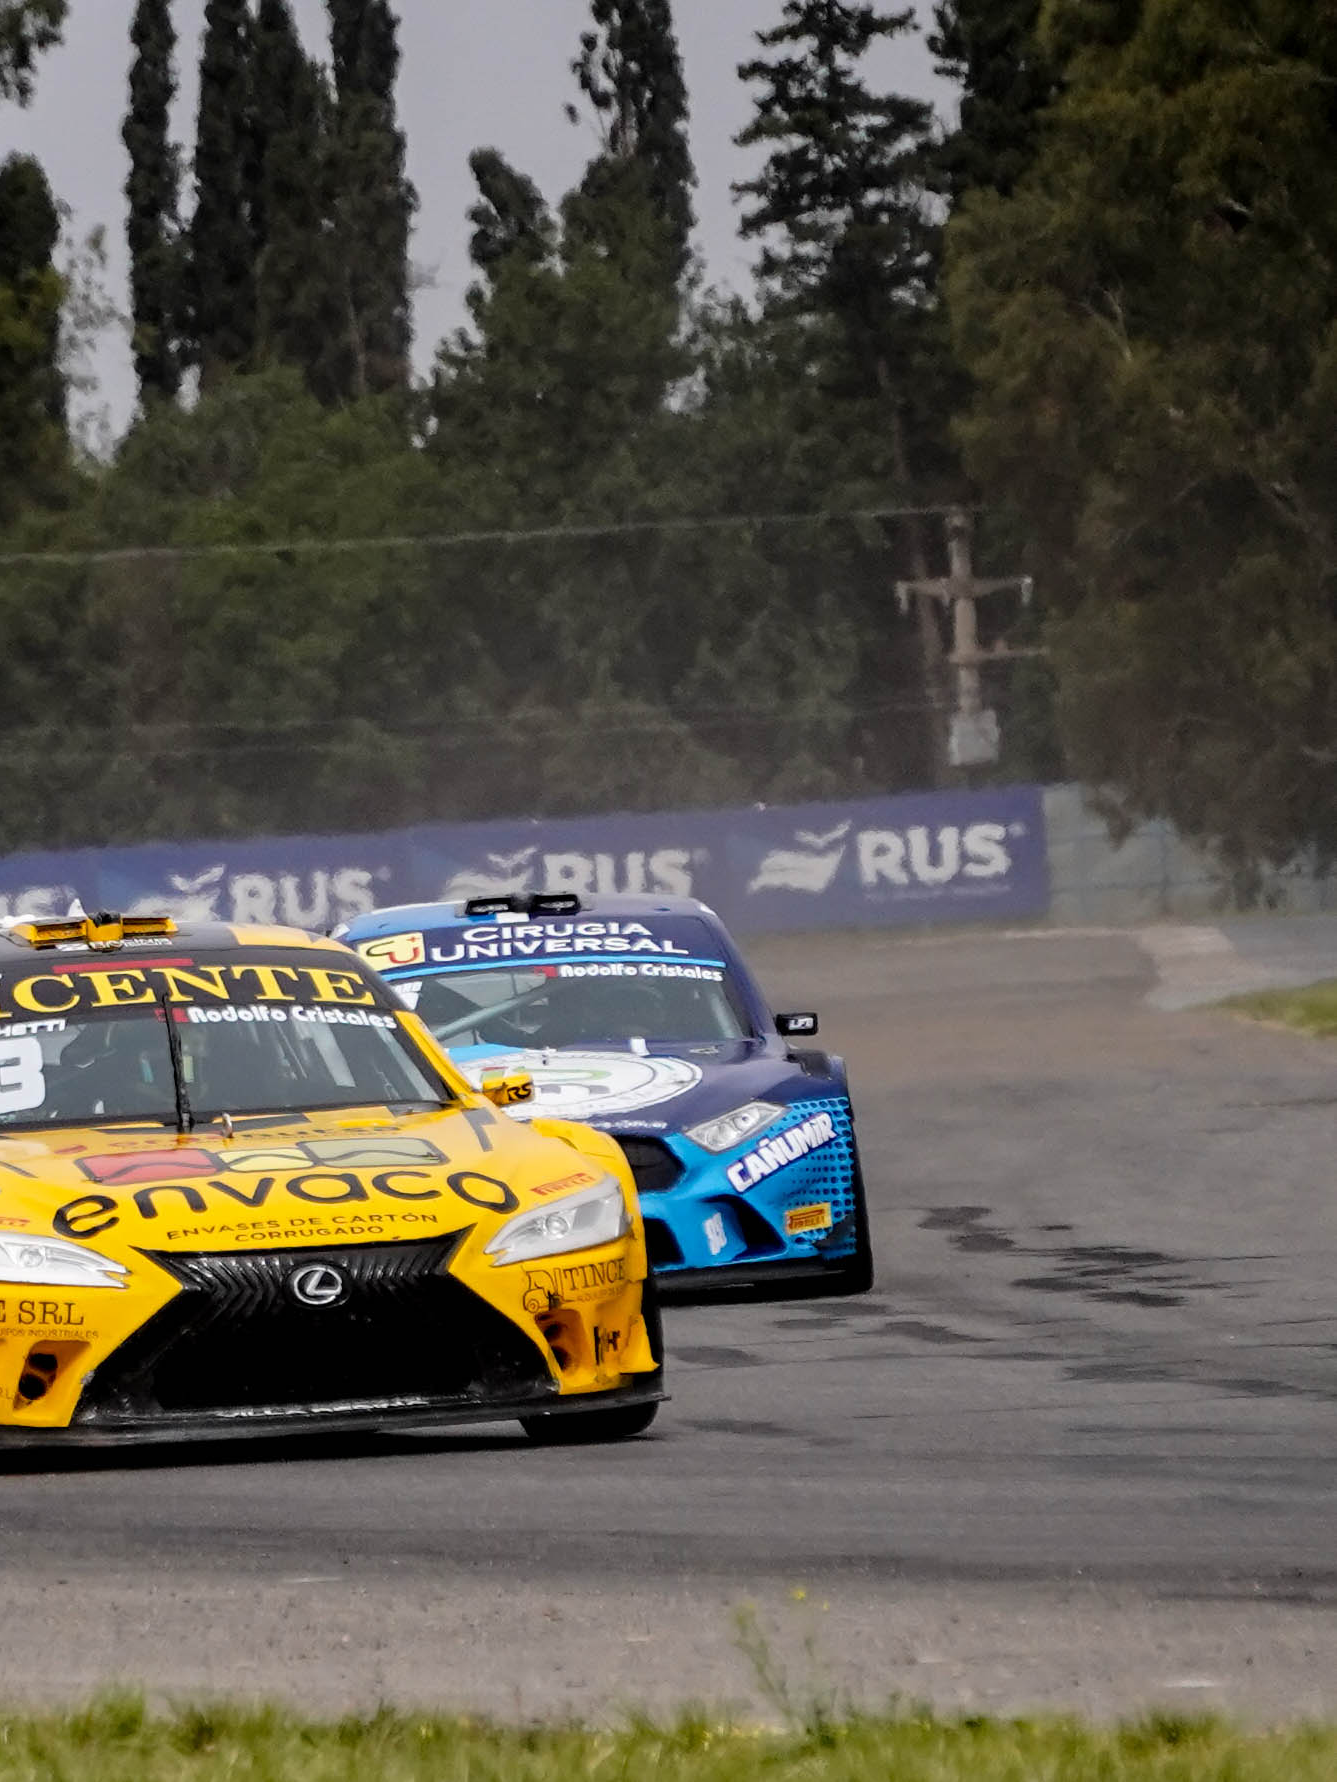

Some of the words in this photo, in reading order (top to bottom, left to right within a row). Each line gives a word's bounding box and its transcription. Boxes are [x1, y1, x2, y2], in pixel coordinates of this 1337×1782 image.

[858, 823, 1011, 885] RUS
[544, 849, 694, 896] RUS
[229, 867, 375, 928] RUS
[463, 921, 652, 942] CIRUGIA
[431, 937, 689, 962] UNIVERSAL
[642, 965, 723, 981] Cristales
[188, 1004, 287, 1024] Rodolfo
[292, 1005, 397, 1029] Cristales
[530, 1172, 596, 1196] PIRELLI
[52, 1172, 520, 1239] envaco
[166, 1219, 271, 1240] ENVASES
[290, 1217, 322, 1227] DE
[332, 1213, 438, 1225] CARTÓN
[788, 1208, 826, 1230] PIRELLI
[234, 1226, 383, 1242] CORRUGADO
[18, 1301, 84, 1326] SRL
